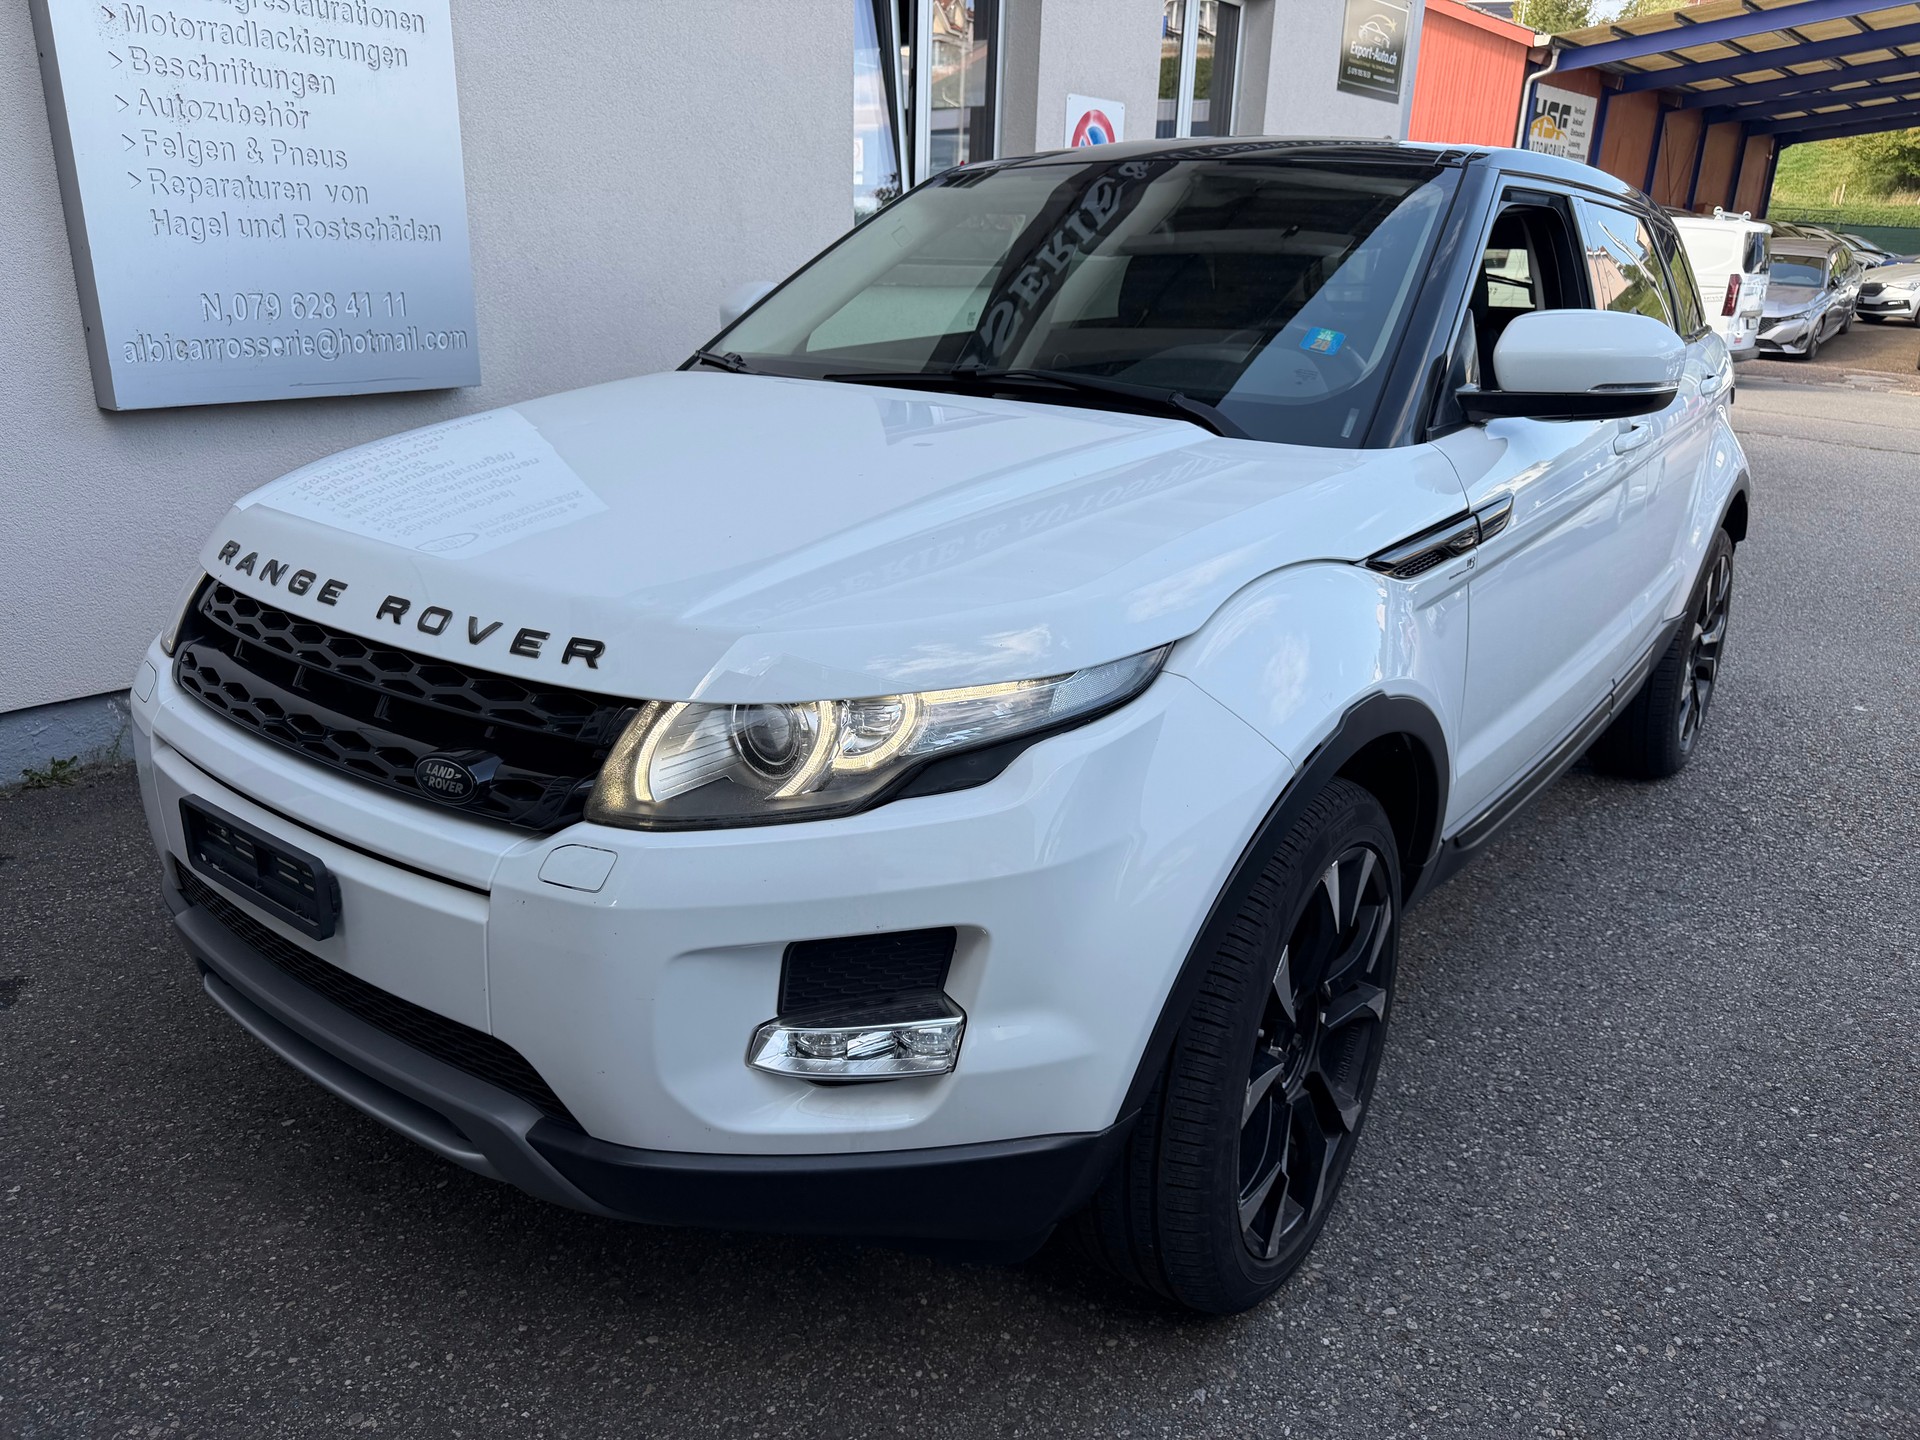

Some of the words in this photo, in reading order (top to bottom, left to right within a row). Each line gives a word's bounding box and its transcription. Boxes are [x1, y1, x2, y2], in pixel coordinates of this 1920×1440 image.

[123, 3, 409, 70] Motorradlackierungen
[1350, 41, 1397, 66] Export-Auto.ch
[127, 46, 337, 96] Beschriftungen
[137, 89, 311, 129] Autozubehör
[141, 129, 237, 167] Felgen
[246, 137, 265, 165] &
[272, 139, 349, 170] Pneus
[147, 168, 313, 204] Reparaturen
[325, 182, 370, 205] von
[150, 208, 229, 243] Hagel
[238, 213, 287, 239] und
[293, 213, 442, 242] Rostschäden
[290, 292, 338, 319] 628
[345, 292, 373, 318] 41
[382, 291, 408, 317] 11
[122, 326, 469, 364] albicarrosserie@hotmail.com
[216, 539, 348, 607] RANGE
[375, 595, 606, 670] ROVER
[425, 762, 455, 780] LAND
[428, 777, 464, 795] ROVER
